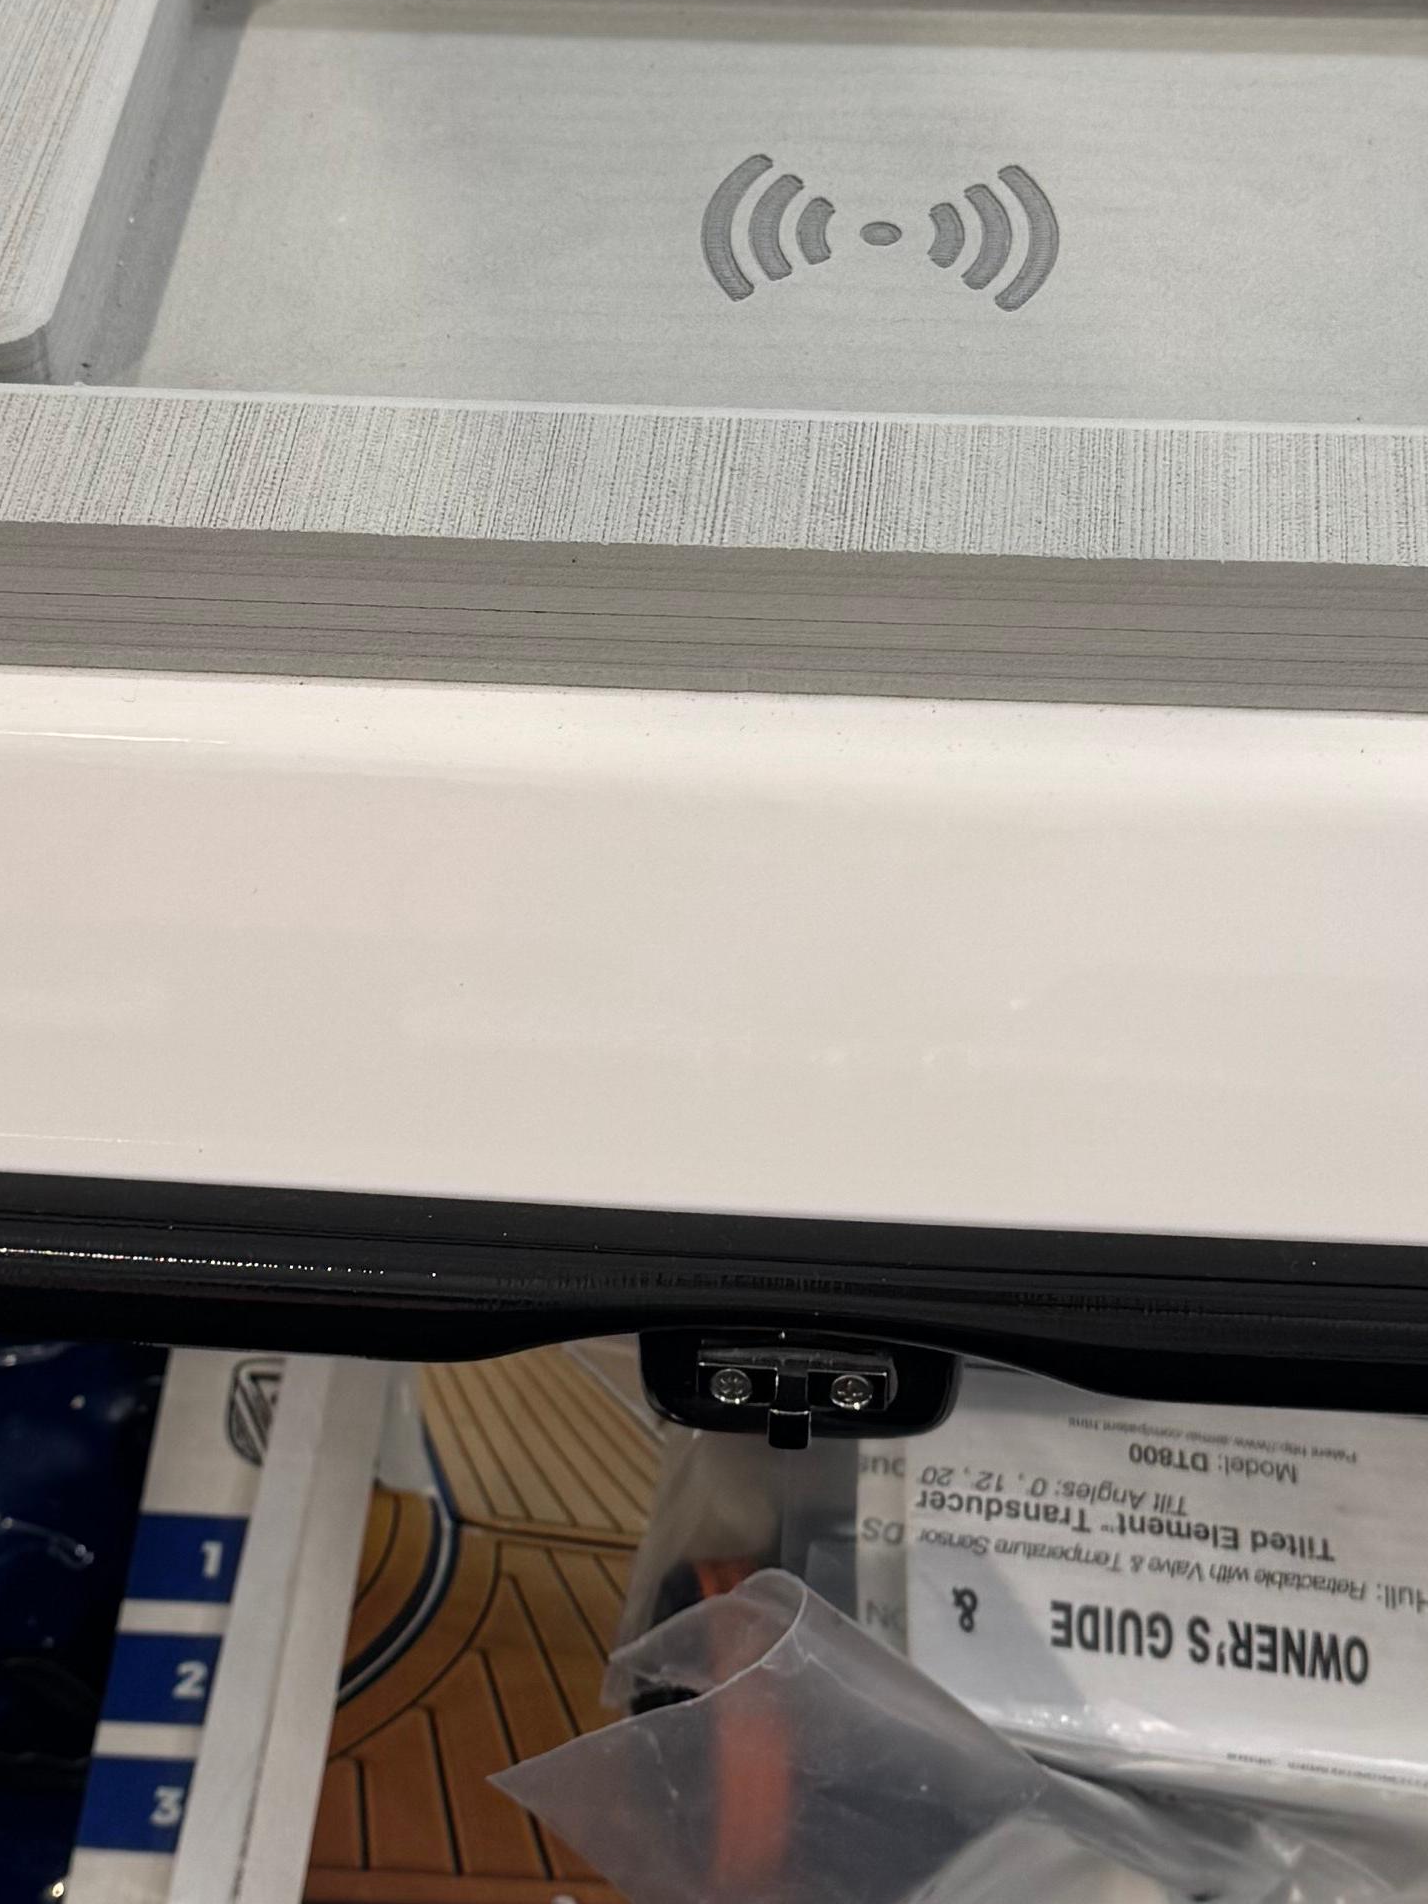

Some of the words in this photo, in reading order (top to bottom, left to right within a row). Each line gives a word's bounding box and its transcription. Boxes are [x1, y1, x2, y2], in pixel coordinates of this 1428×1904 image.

[1129, 1443, 1208, 1473] DT800
[1219, 1454, 1297, 1484] Model:
[1057, 1478, 1147, 1510] Angles:
[1154, 1493, 1189, 1517] Tilt
[916, 1491, 1091, 1533] Transducer
[918, 1530, 990, 1555] Sensor
[994, 1539, 1121, 1574] Temperature
[1251, 1529, 1336, 1562] Tilted
[201, 1541, 222, 1578] 1
[1130, 1554, 1141, 1574] &
[1148, 1555, 1204, 1581] Valve
[1210, 1563, 1249, 1585] with
[1254, 1568, 1367, 1601] Retractable
[953, 1587, 978, 1633] &
[1050, 1599, 1172, 1659] GUIDE
[1188, 1615, 1369, 1685] OWNER'S
[174, 1661, 208, 1699] 2
[150, 1786, 184, 1827] 3
